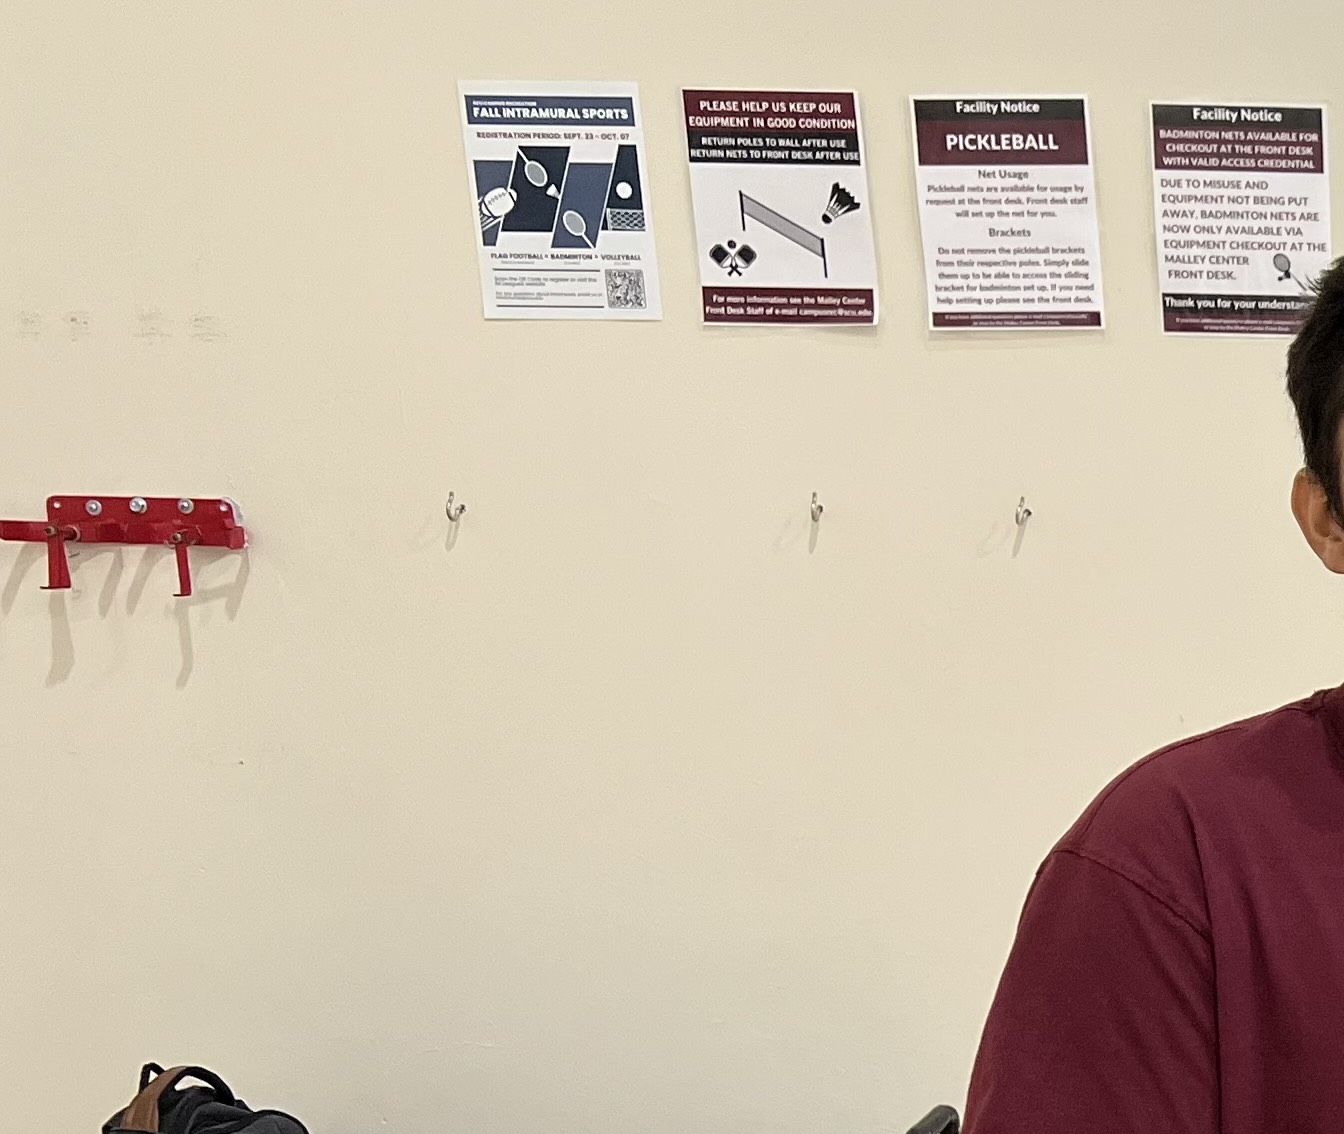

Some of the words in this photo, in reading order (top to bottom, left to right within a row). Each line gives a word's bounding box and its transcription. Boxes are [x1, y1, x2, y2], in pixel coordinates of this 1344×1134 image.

[700, 101, 739, 111] PLEASE
[742, 102, 769, 112] HELP
[772, 102, 786, 112] US
[789, 103, 816, 112] KEEP
[818, 103, 841, 113] OUR
[956, 101, 998, 115] Facility
[1001, 102, 1040, 113] Notice
[473, 107, 501, 118] FALL
[503, 108, 580, 119] INTRAMURAL
[582, 109, 628, 119] SPORTS
[1193, 108, 1238, 122] Facility
[1241, 110, 1282, 122] Notice
[689, 116, 749, 127] EQUIPMENT
[753, 118, 764, 127] IN
[767, 118, 796, 128] GOOD
[799, 119, 855, 129] CONDITION
[1160, 130, 1219, 140] BADMINTON
[1222, 132, 1244, 140] NETS
[1247, 132, 1297, 141] AVAILABLE
[1299, 133, 1318, 142] FOR
[702, 137, 735, 145] RETURN
[738, 138, 763, 146] POLES
[778, 139, 800, 147] WALL
[802, 139, 827, 147] AFTER
[830, 140, 846, 148] USE
[946, 134, 1059, 150] PICKLEBALL
[691, 149, 724, 157] RETURN
[726, 150, 747, 158] NETS
[763, 151, 789, 159] FRONT
[792, 151, 812, 160] DESK
[815, 152, 841, 160] AFTER
[1166, 145, 1217, 153] CHECKOUT
[1220, 145, 1232, 153] AT
[1235, 145, 1252, 154] THE
[1255, 146, 1286, 154] FRONT
[1288, 147, 1313, 155] DESK
[1191, 158, 1219, 166] VALID
[1221, 158, 1255, 167] ACCESS
[1258, 159, 1314, 168] CREDENTIAL
[978, 170, 996, 179] Net
[999, 170, 1028, 180] Usage
[928, 185, 964, 193] Pickleball
[1074, 185, 1084, 193] by
[1161, 179, 1182, 188] DUE
[1185, 180, 1200, 188] TO
[1203, 180, 1241, 189] MISUSE
[1245, 181, 1268, 190] AND
[926, 198, 955, 206] request
[1162, 195, 1224, 204] EQUIPMENT
[1228, 195, 1250, 204] NOT
[1254, 196, 1285, 205] BEING
[1288, 197, 1309, 206] PUT
[1162, 210, 1198, 219] AWAY,
[1201, 210, 1267, 220] BADMINTON
[1270, 212, 1296, 221] NETS
[1299, 213, 1319, 222] ARE
[989, 228, 1031, 237] Brackets
[1163, 225, 1191, 233] NOW
[1194, 225, 1222, 234] ONLY
[1226, 226, 1282, 235] AVAILABLE
[1284, 227, 1303, 236] VIA
[1013, 247, 1049, 255] pickleball
[1164, 240, 1226, 249] EQUIPMENT
[1230, 241, 1287, 251] CHECKOUT
[1290, 242, 1305, 251] AT
[1307, 243, 1326, 251] THE
[1044, 259, 1069, 268] Simply
[1165, 255, 1206, 264] MALLEY
[1209, 256, 1249, 265] CENTER
[1169, 270, 1203, 279] FRONT
[1207, 271, 1236, 279] DESK.
[937, 297, 953, 305] help
[1165, 297, 1194, 307] Thank
[1197, 300, 1215, 310] you
[1217, 298, 1231, 307] for
[1234, 301, 1256, 311] your
